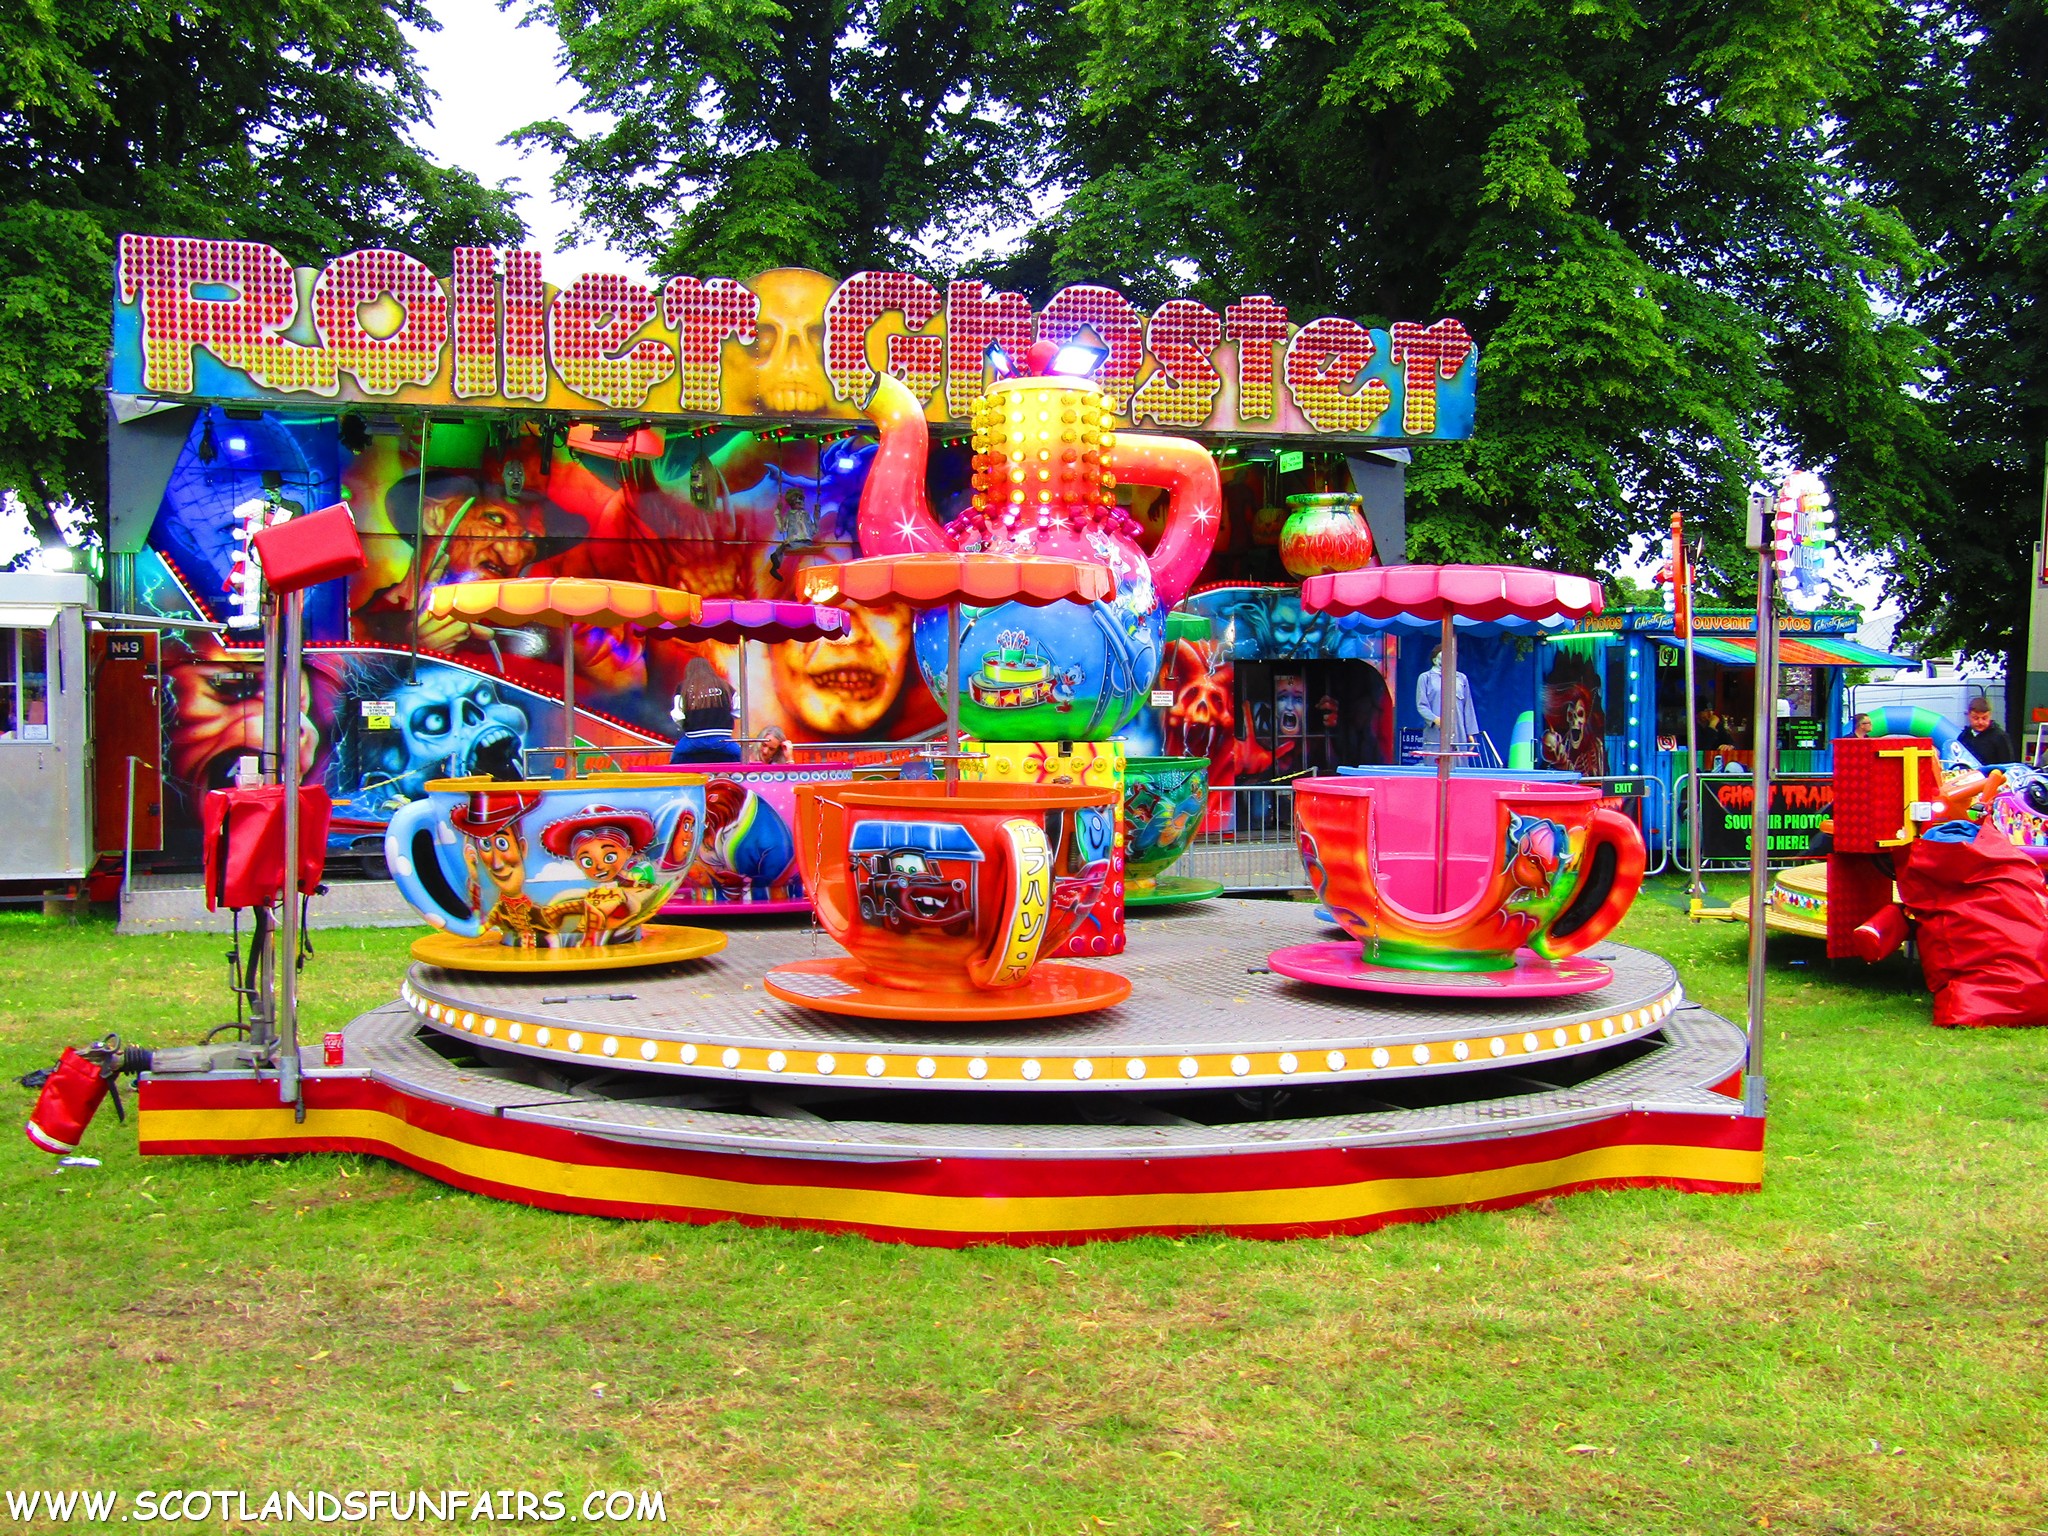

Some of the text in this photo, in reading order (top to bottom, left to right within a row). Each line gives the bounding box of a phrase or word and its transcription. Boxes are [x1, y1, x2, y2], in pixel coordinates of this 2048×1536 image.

[118, 233, 1476, 435] Roller Ghoster
[1585, 617, 1622, 630] Photos
[1692, 616, 1811, 631] ouvenir otos
[111, 641, 139, 653] N49
[1614, 782, 1633, 794] EXIT
[1718, 785, 1777, 810] GHOT
[1745, 835, 1809, 850] SD HERE!
